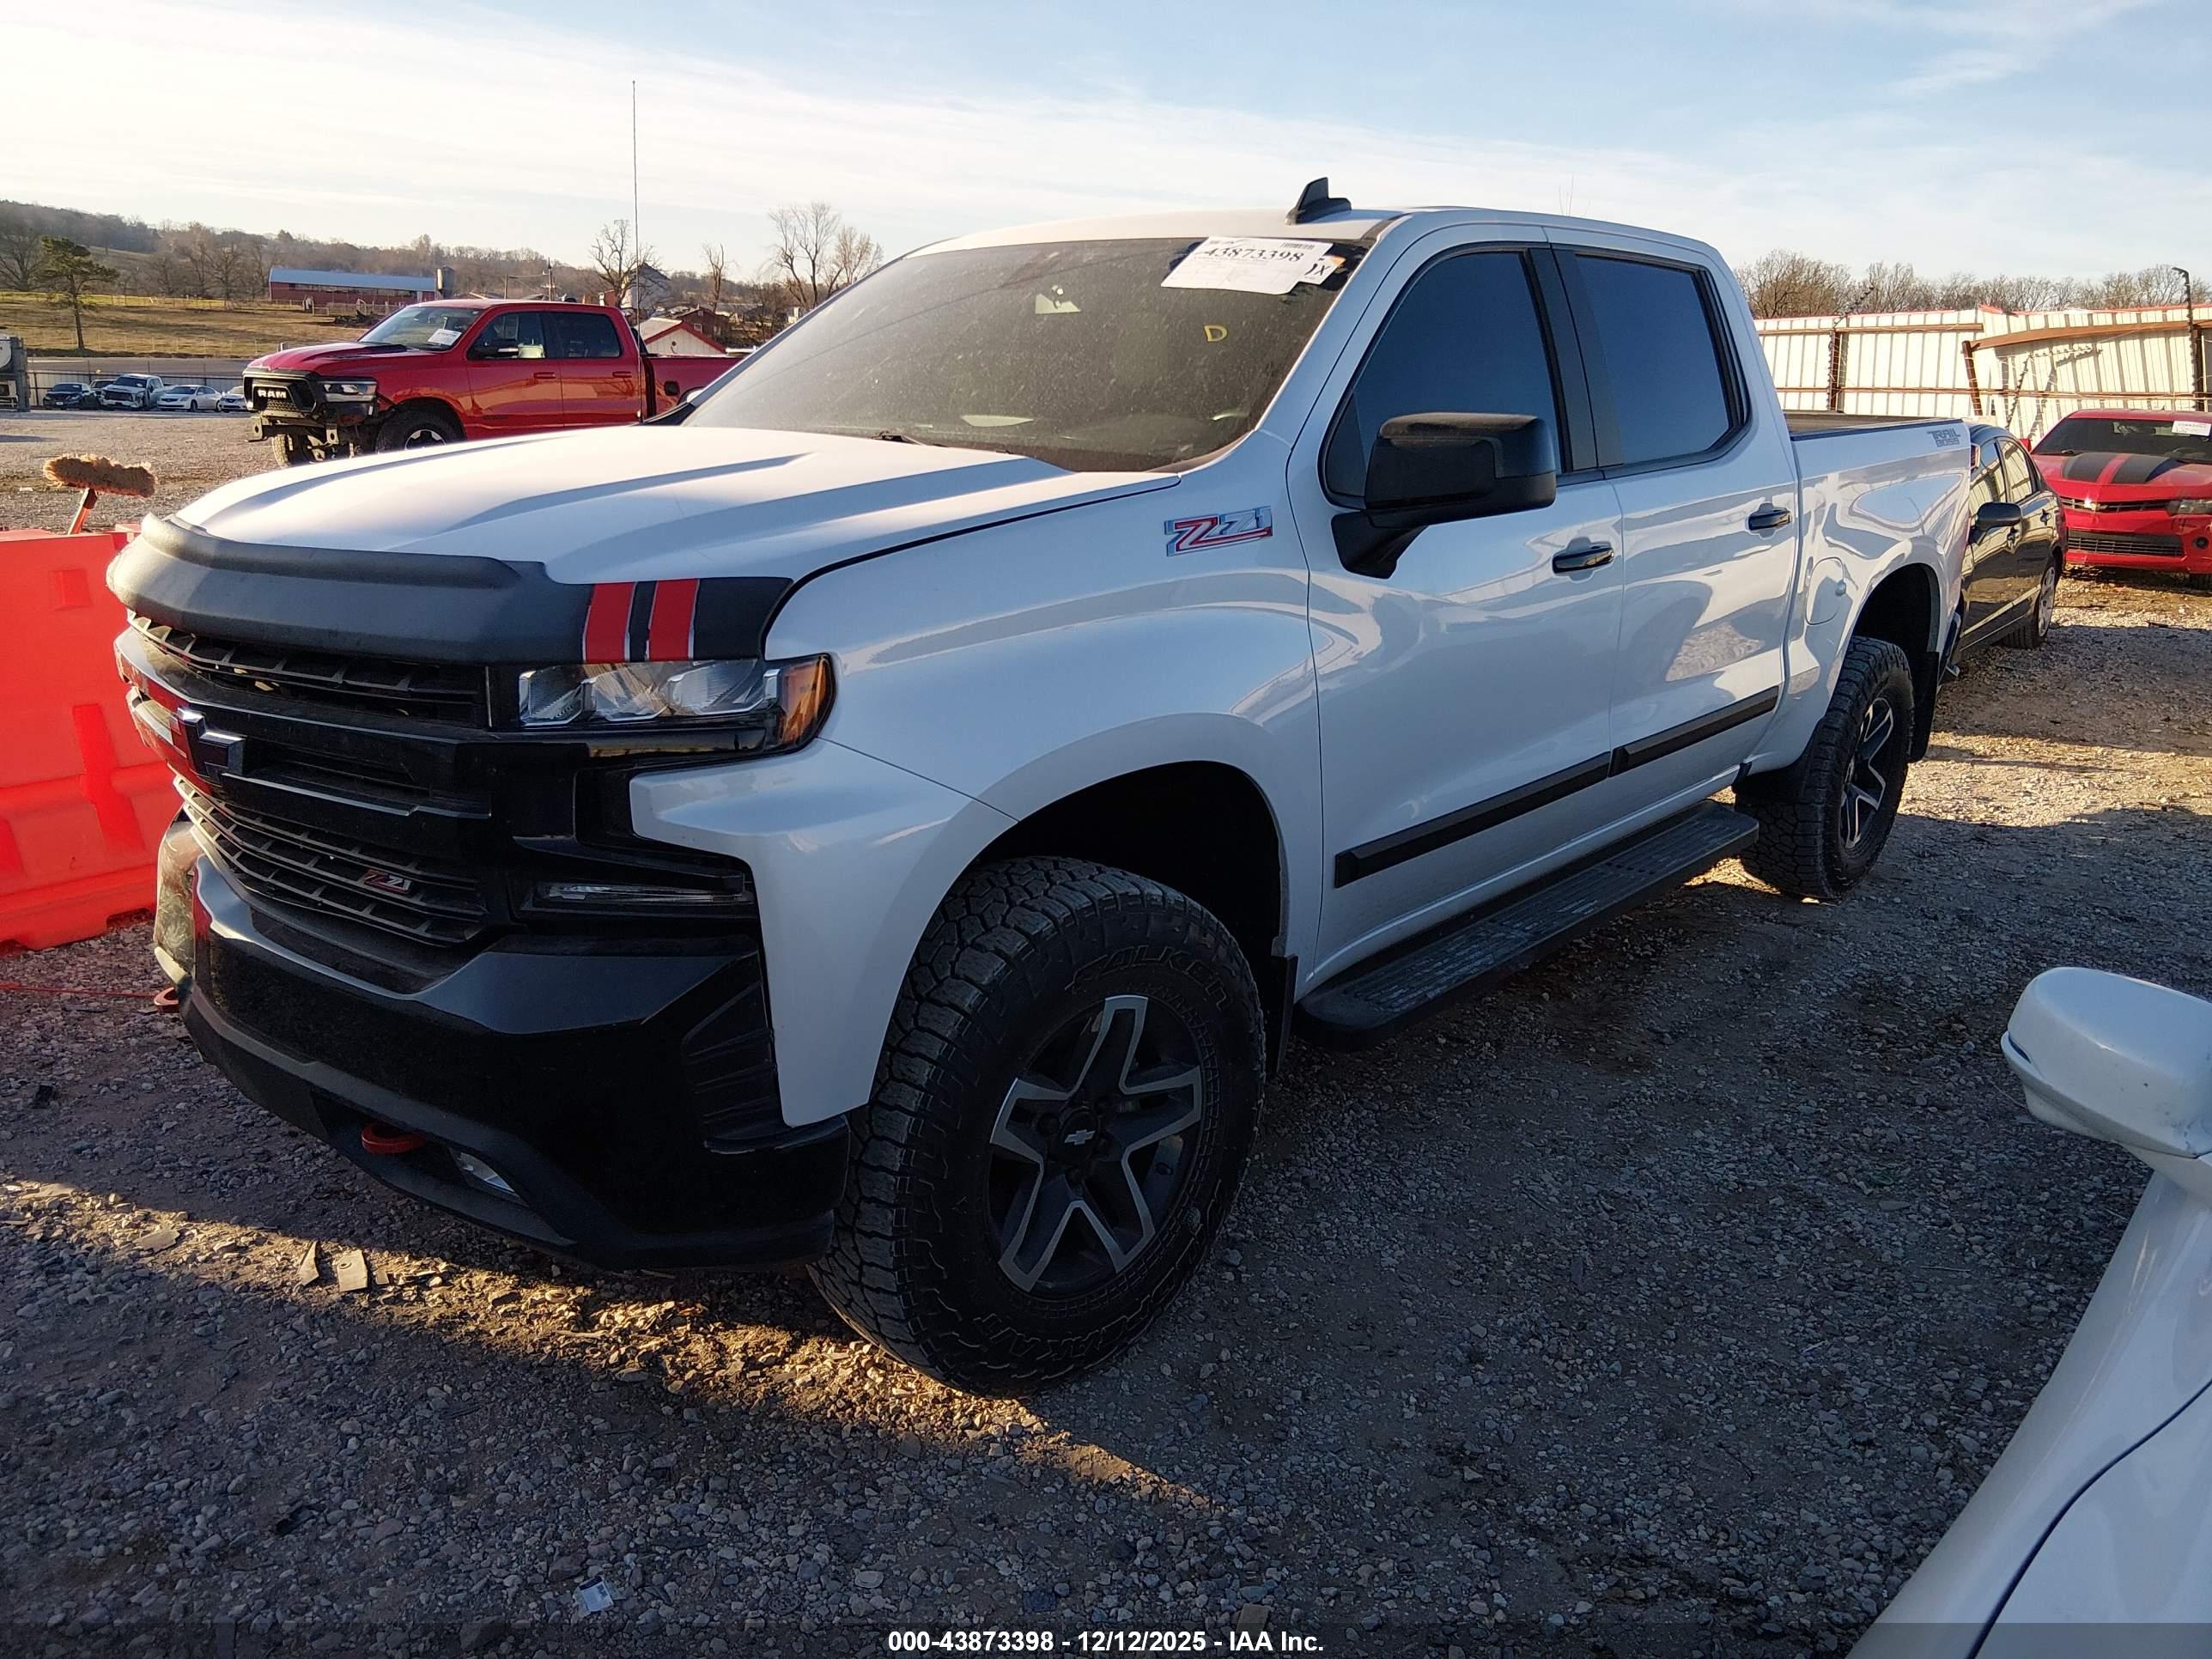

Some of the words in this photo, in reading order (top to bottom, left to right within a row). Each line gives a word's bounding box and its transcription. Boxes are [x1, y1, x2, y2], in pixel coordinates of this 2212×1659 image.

[1204, 246, 1304, 263] 43873398
[1203, 325, 1228, 343] D
[258, 389, 288, 399] RAM
[1927, 428, 1961, 439] TRAIL
[1935, 437, 1960, 447] BOSS
[1164, 506, 1273, 556] Z71
[363, 867, 413, 895] Z71
